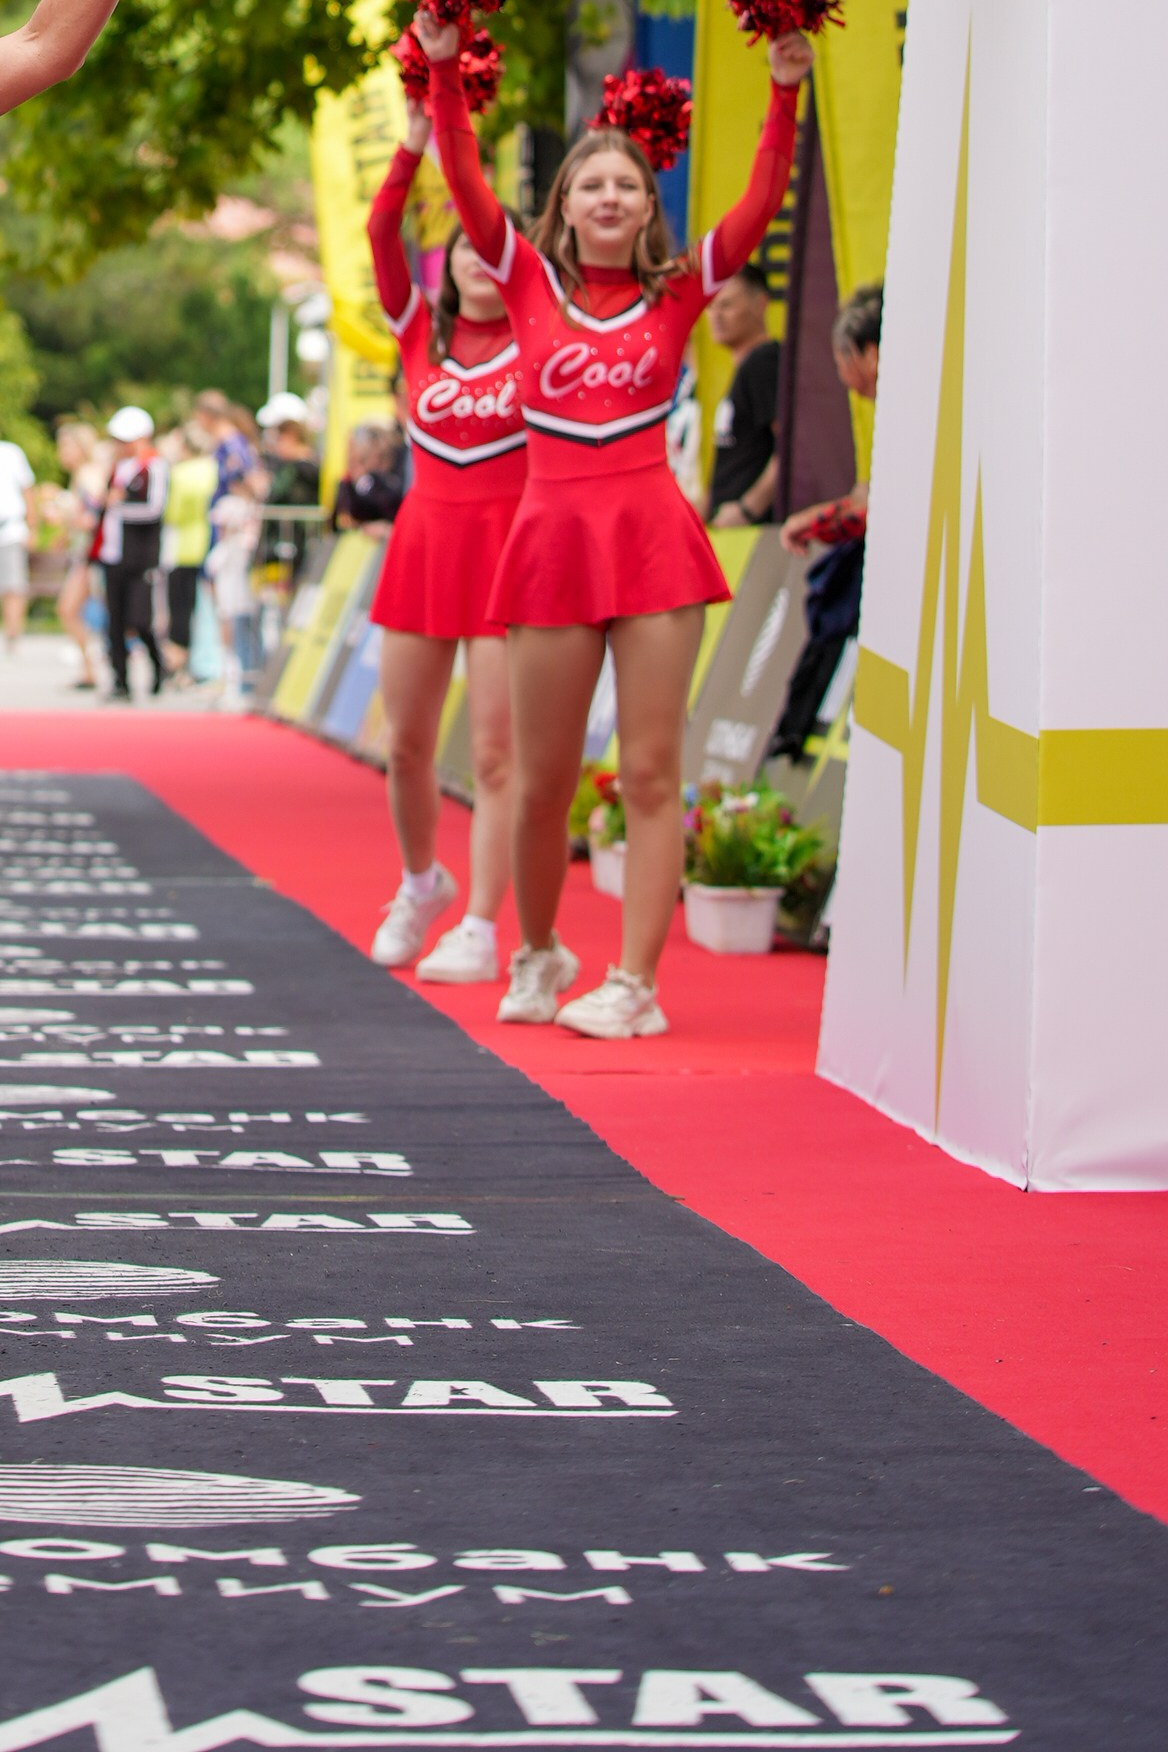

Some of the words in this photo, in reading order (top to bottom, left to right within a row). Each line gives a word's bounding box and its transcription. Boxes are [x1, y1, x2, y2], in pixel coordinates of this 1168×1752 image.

[539, 342, 658, 400] Cool
[417, 378, 517, 424] Cool
[52, 1148, 412, 1171] STAR
[74, 1211, 473, 1229] STAR
[160, 1374, 674, 1408] STAR
[296, 1665, 1011, 1728] STAR
